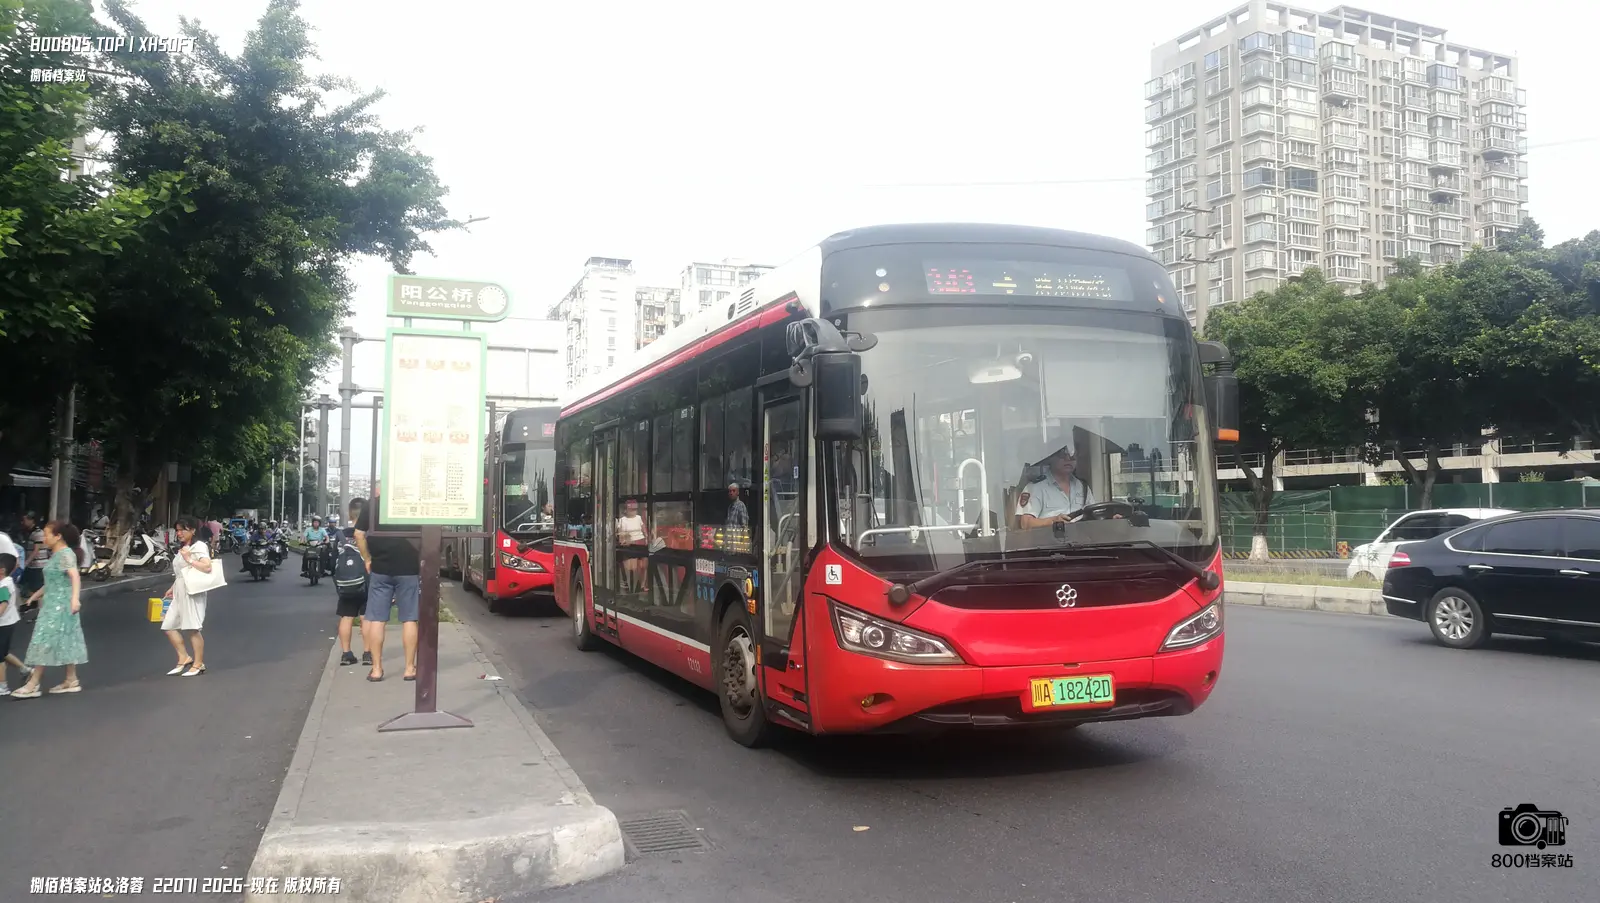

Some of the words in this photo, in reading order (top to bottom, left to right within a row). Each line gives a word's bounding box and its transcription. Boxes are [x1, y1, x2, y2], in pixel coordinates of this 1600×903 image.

[401, 285, 474, 302] 阳公桥
[400, 299, 472, 309] Yanggongqiao
[1059, 679, 1111, 701] 18242D
